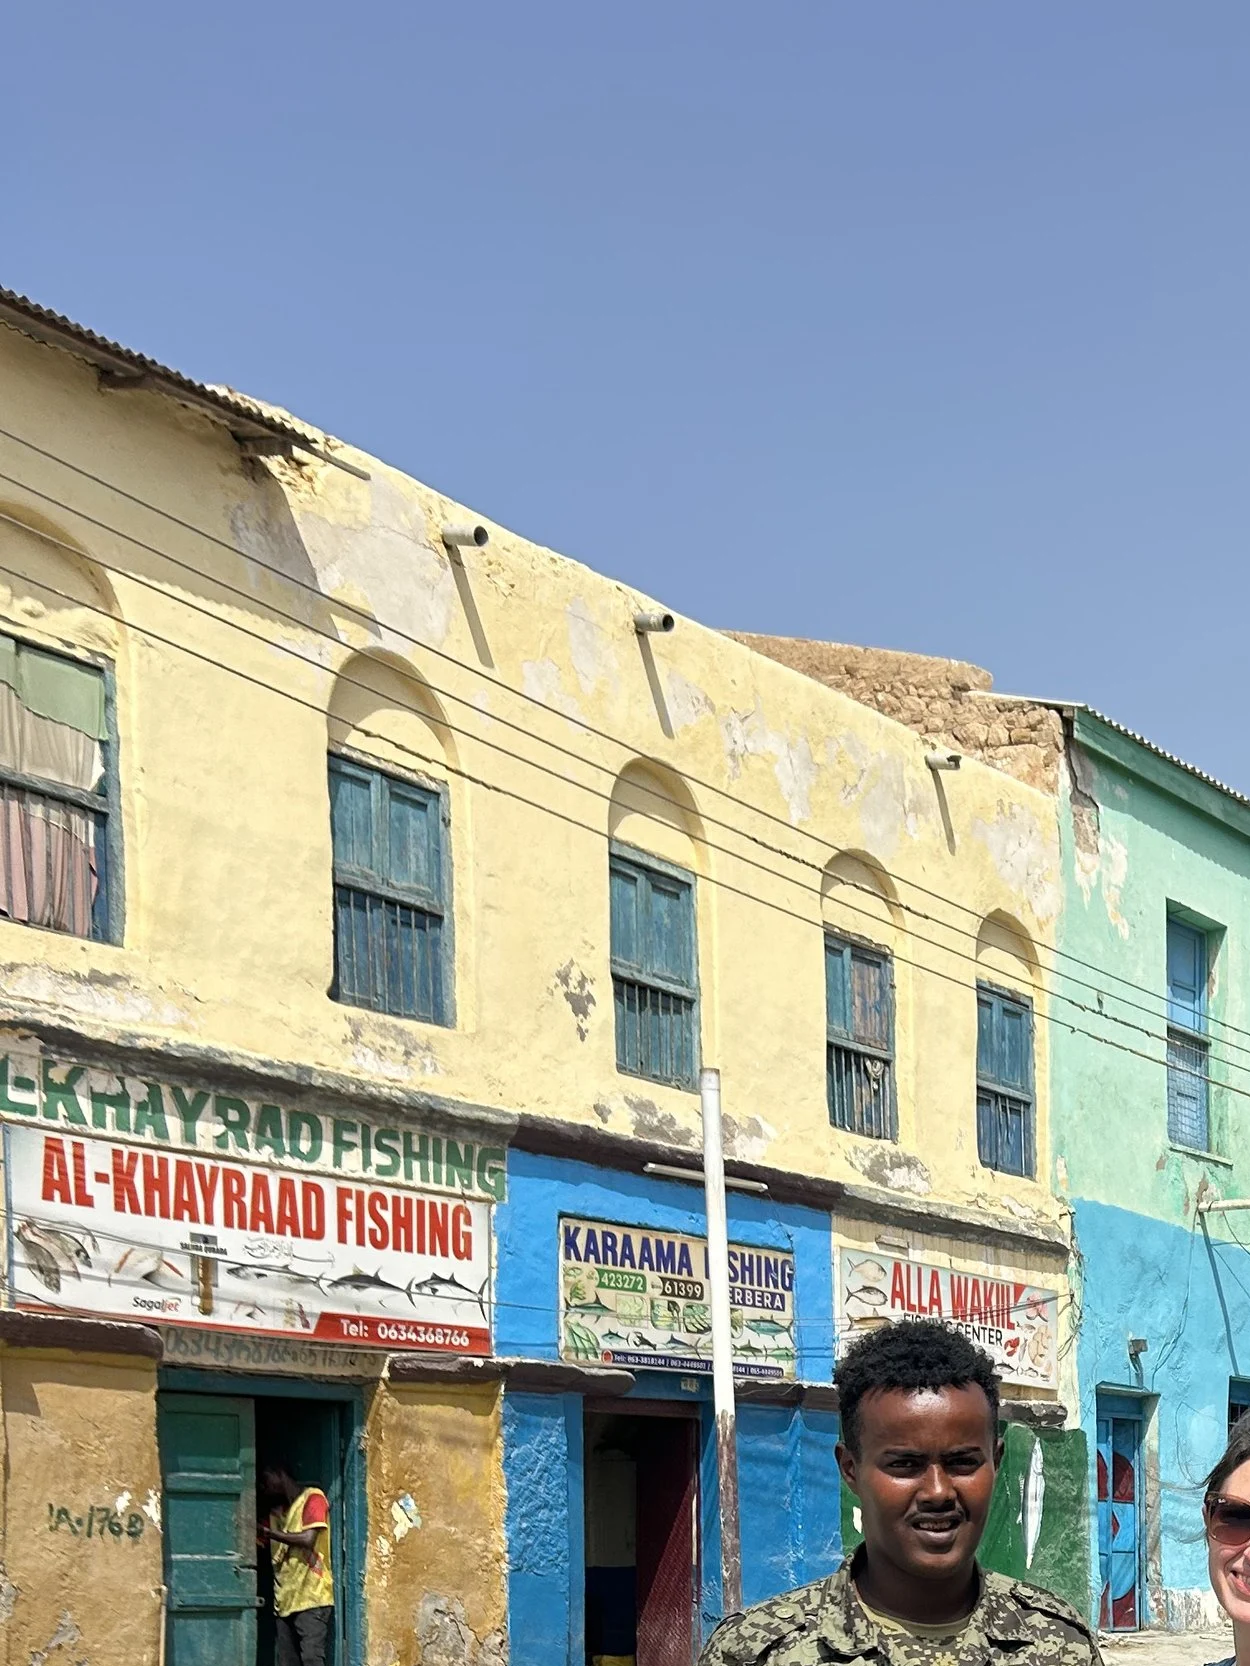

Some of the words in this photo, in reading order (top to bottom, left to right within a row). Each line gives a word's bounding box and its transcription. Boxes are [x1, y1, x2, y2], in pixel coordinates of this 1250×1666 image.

[333, 1118, 507, 1202] FISHING
[41, 1136, 326, 1241] AL-KHAYRAAD
[336, 1186, 473, 1262] FISHING
[564, 1225, 694, 1277] KARAAMA
[704, 1246, 795, 1292] SHING
[601, 1272, 644, 1291] 423272
[664, 1281, 702, 1298] 61399
[729, 1287, 783, 1310] ERBERA
[890, 1261, 943, 1317] ALLA
[950, 1273, 1016, 1331] WAKIIL
[340, 1319, 369, 1338] Tel:
[377, 1322, 470, 1347] 0634368766
